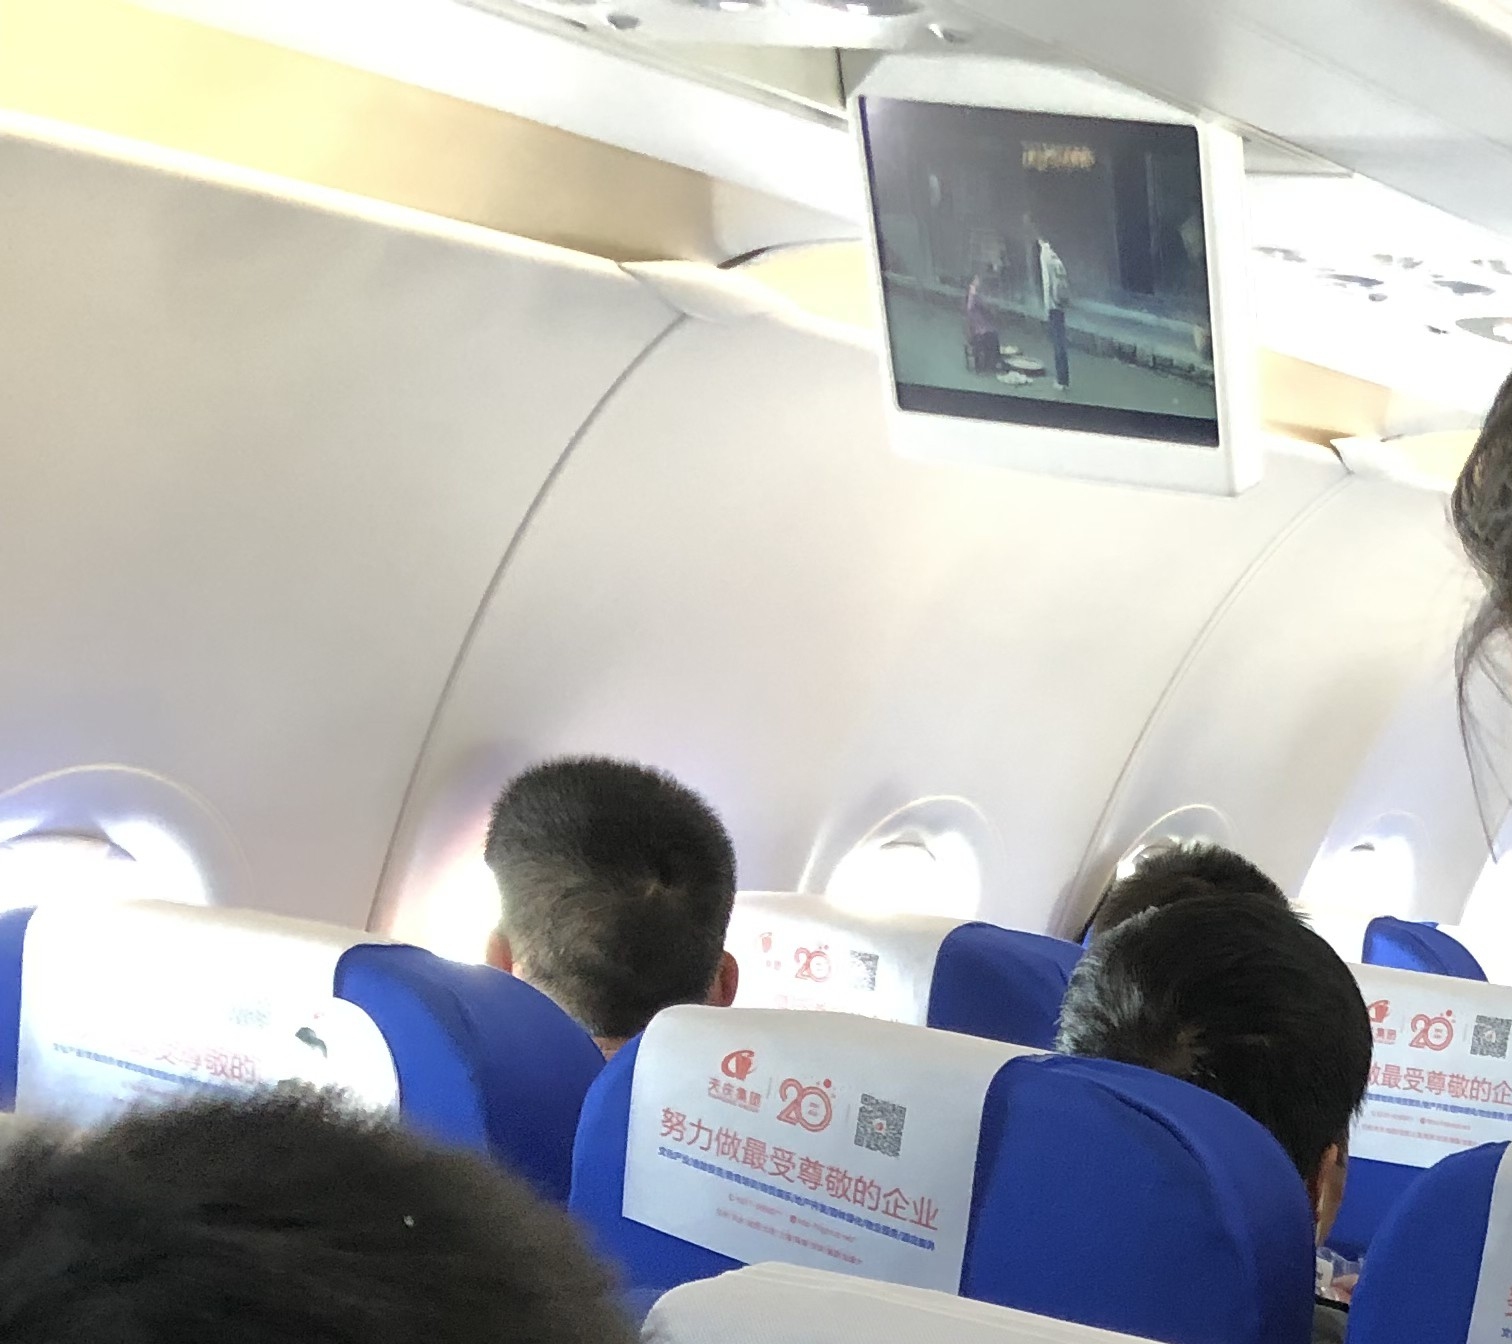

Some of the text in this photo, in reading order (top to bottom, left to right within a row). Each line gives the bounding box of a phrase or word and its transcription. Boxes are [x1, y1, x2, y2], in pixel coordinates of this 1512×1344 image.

[1409, 1013, 1454, 1052] 20
[776, 1078, 832, 1133] 20
[660, 1107, 939, 1231] 努力做最受尊敬的企业
